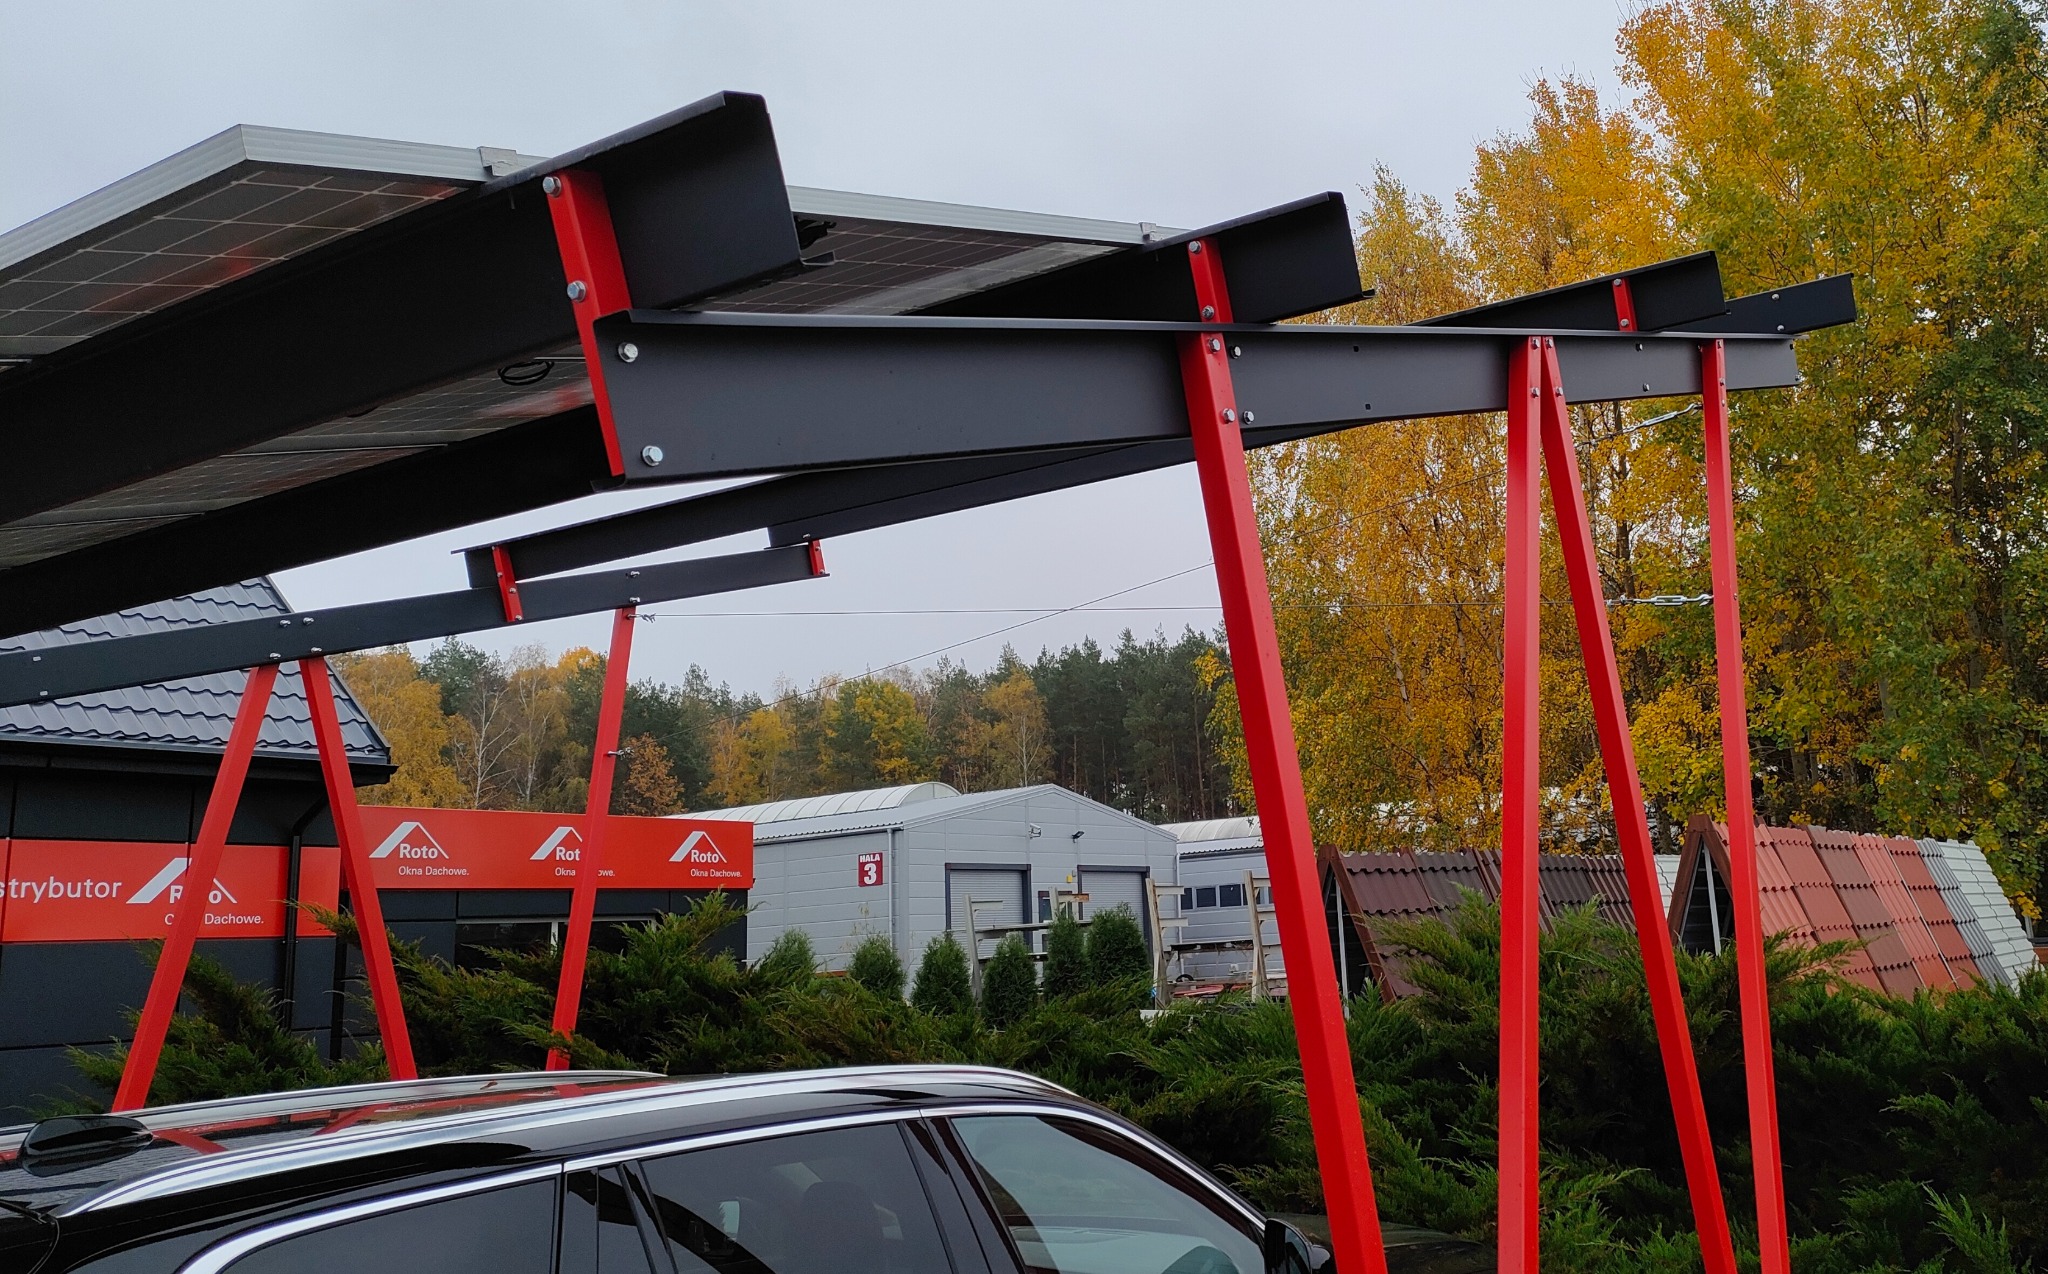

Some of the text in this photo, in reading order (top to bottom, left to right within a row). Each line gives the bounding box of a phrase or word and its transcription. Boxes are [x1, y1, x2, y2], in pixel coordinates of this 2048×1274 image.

[399, 843, 438, 859] Roto
[555, 846, 581, 861] Rot
[690, 849, 720, 863] Roto
[859, 853, 880, 863] HALA
[398, 865, 470, 876] Okna Dachowe.
[554, 866, 576, 877] Okna
[690, 868, 743, 878] Okna Dachowe.
[863, 862, 877, 885] 3
[169, 885, 222, 904] Ro
[204, 913, 264, 925] Dachowe.
